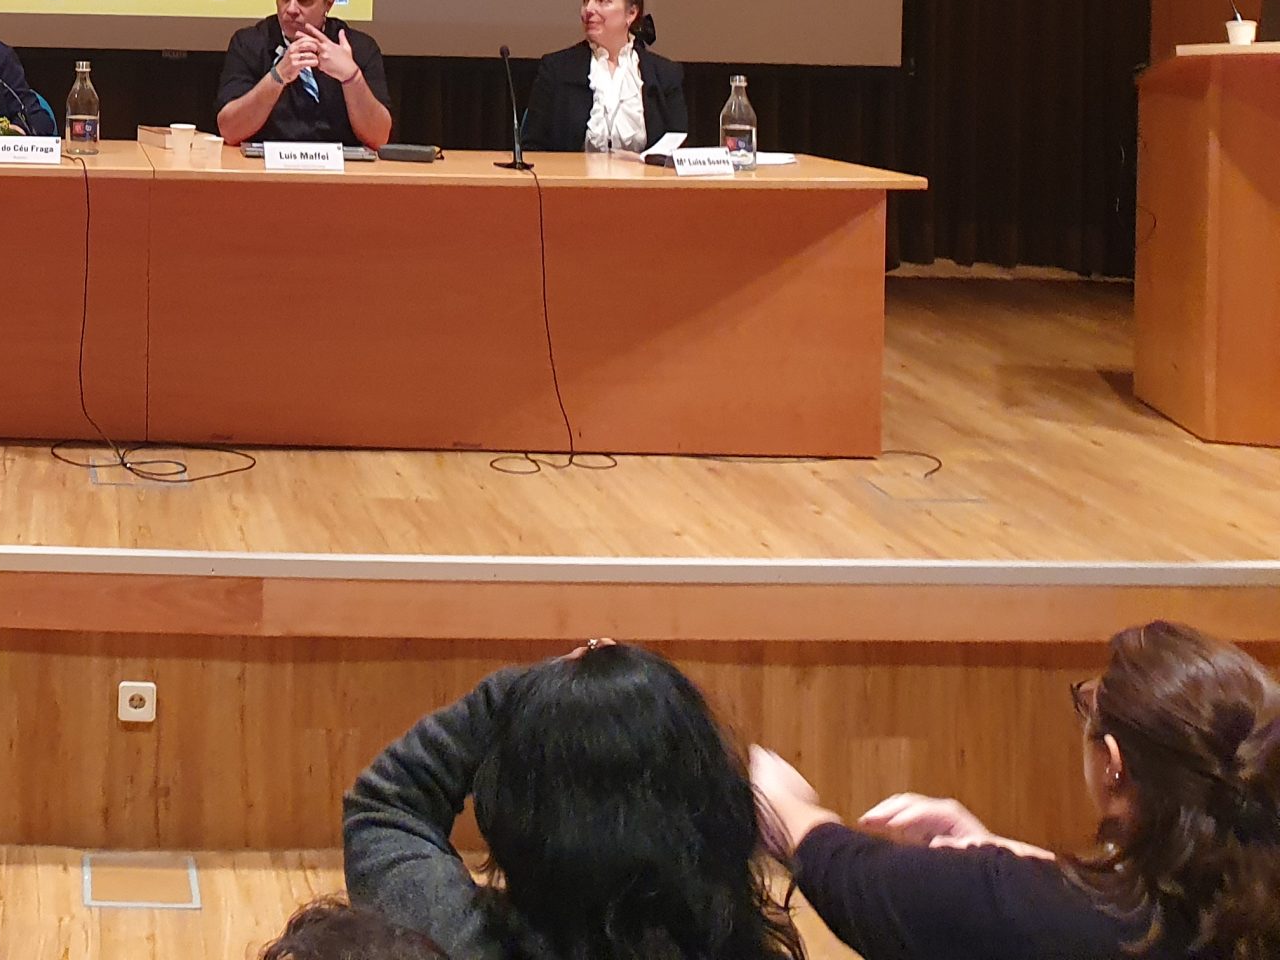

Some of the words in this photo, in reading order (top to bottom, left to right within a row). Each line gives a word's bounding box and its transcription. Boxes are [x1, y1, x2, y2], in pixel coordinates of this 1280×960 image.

[1, 144, 12, 152] do
[13, 144, 29, 152] Céu
[30, 144, 55, 154] Fraga
